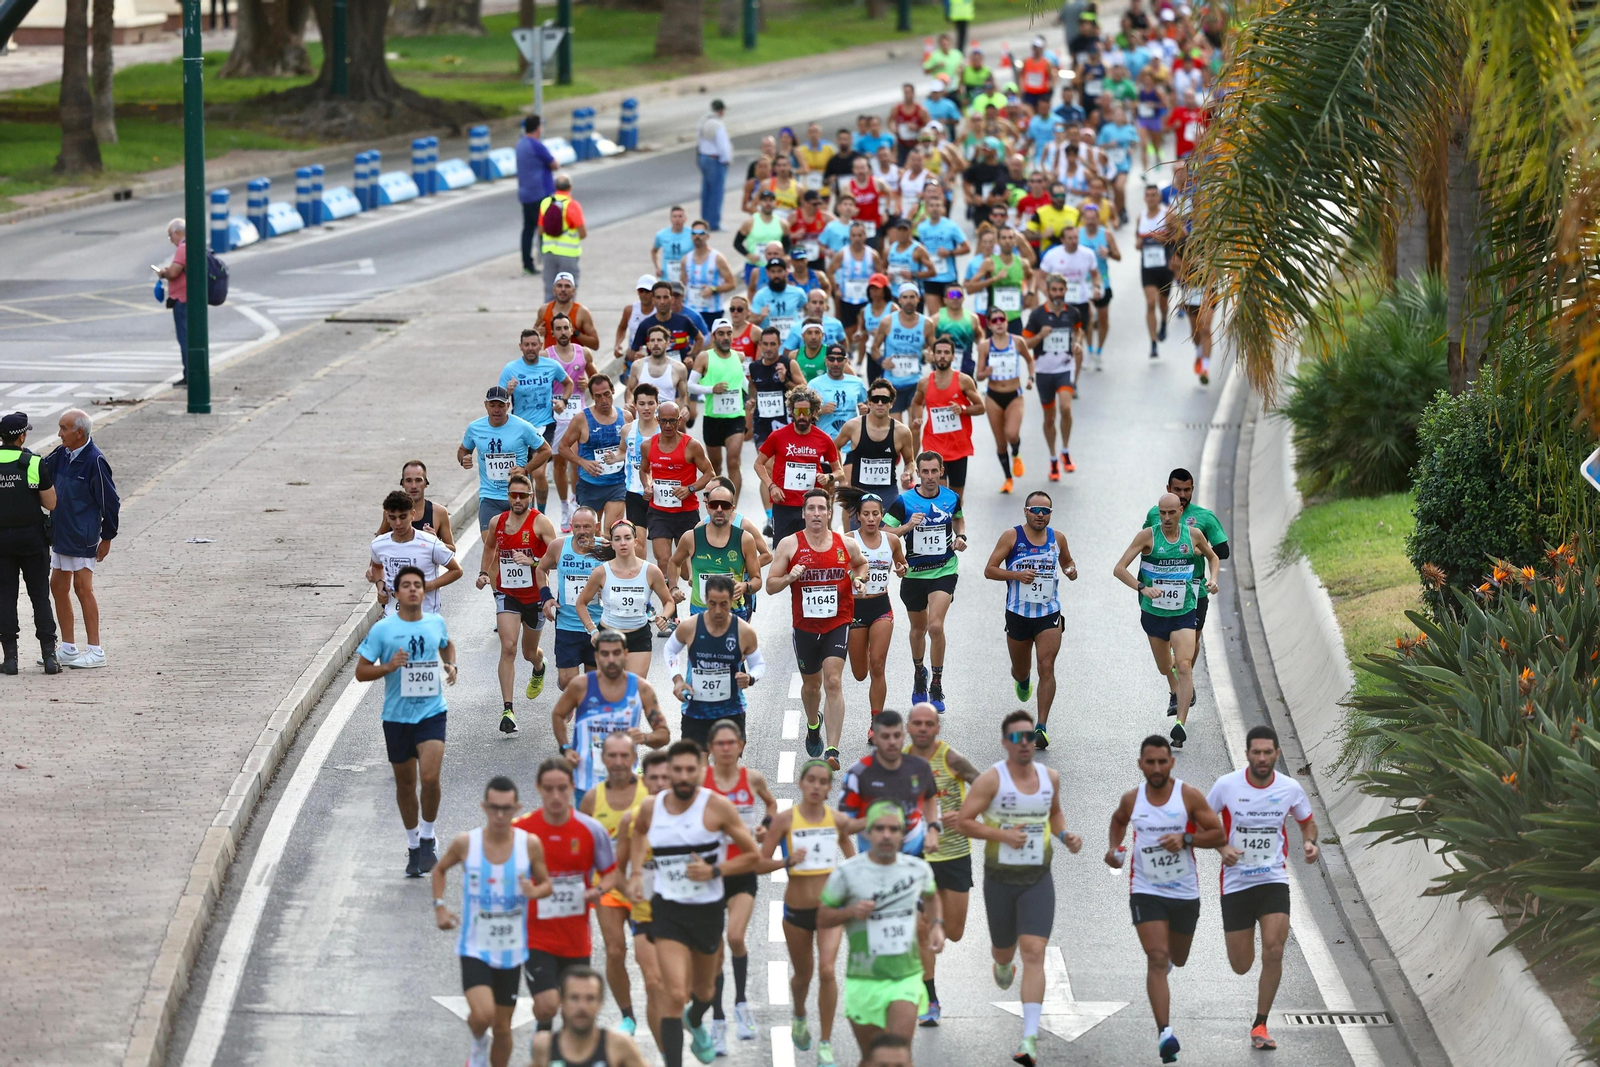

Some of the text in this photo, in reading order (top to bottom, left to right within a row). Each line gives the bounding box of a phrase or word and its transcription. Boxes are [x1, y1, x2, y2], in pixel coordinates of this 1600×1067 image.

[893, 332, 920, 344] nerja
[518, 376, 549, 386] nerja
[936, 414, 956, 423] 1210
[488, 460, 515, 470] 11020
[863, 466, 889, 475] 11703
[795, 473, 807, 481] 44
[922, 535, 940, 544] 115
[562, 560, 592, 570] nerja
[506, 568, 524, 578] 200
[1031, 582, 1043, 592] 31
[1161, 590, 1179, 599] 146
[622, 597, 634, 606] 39
[805, 595, 836, 605] 11645
[408, 672, 434, 682] 3260
[702, 680, 721, 690] 267
[1242, 838, 1271, 850] 1426
[1150, 854, 1181, 869] 1422
